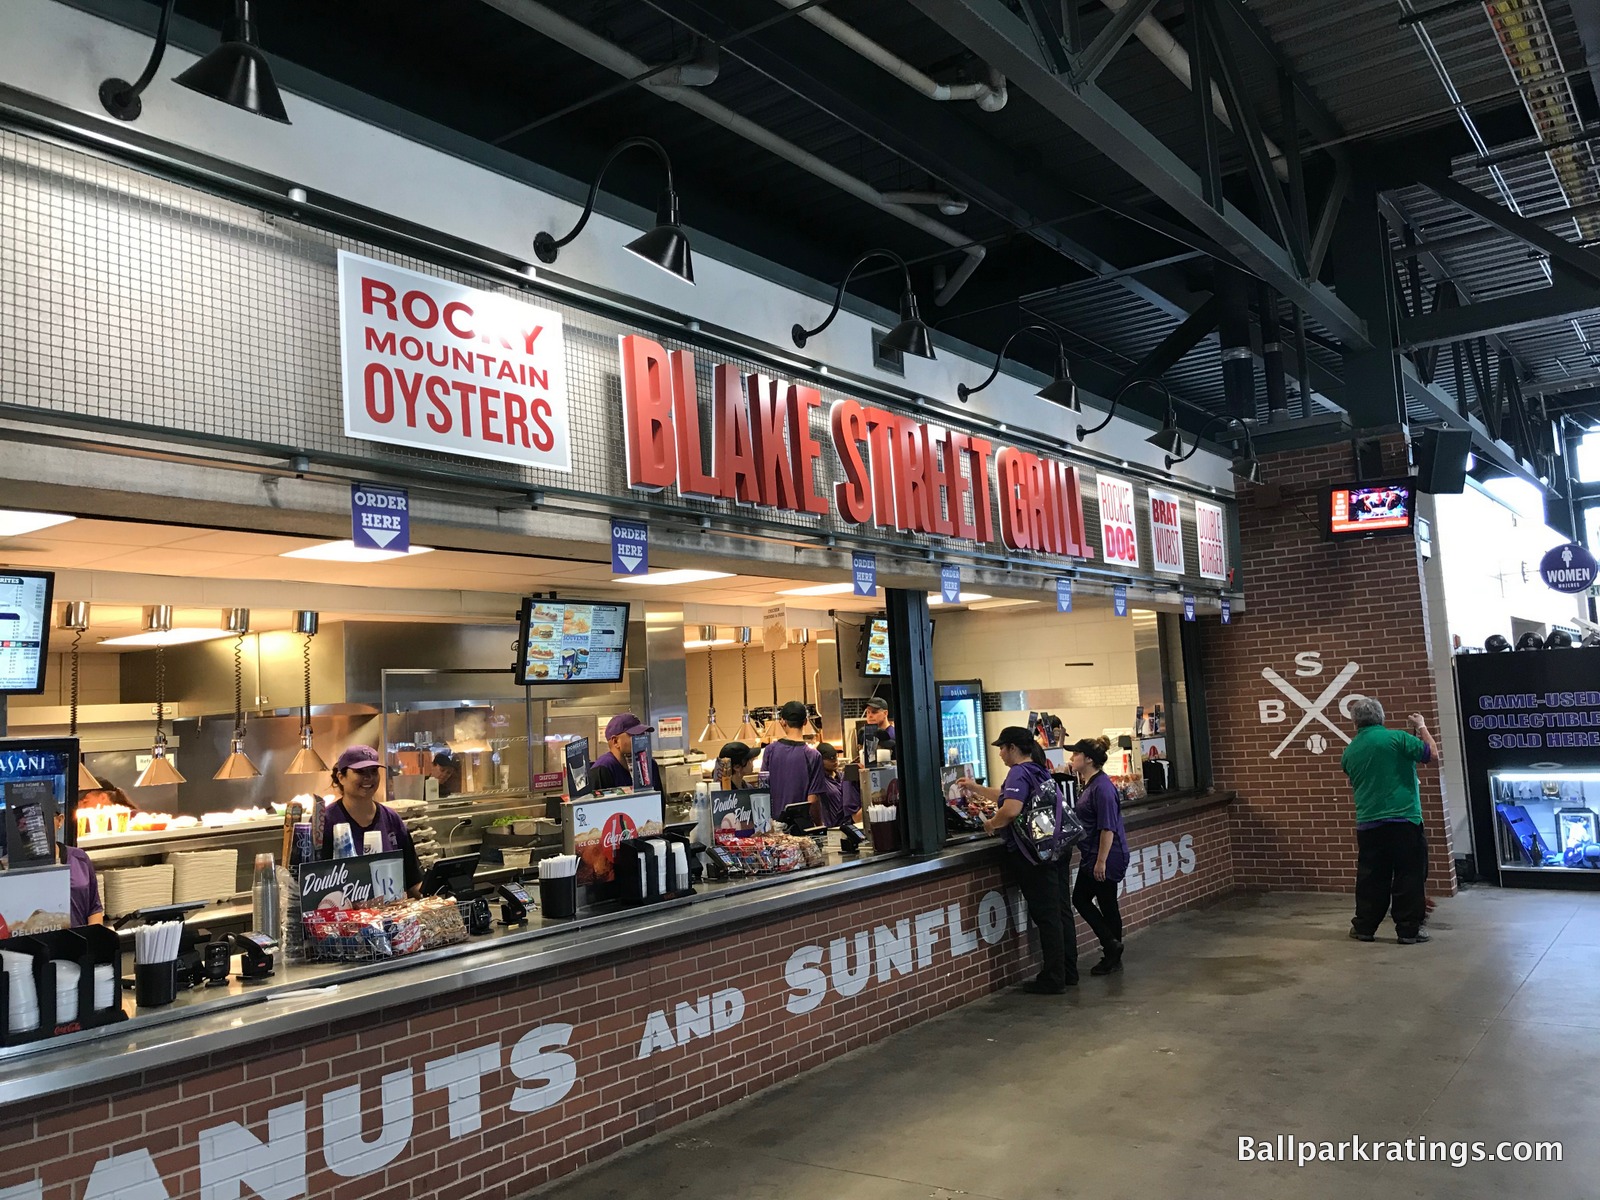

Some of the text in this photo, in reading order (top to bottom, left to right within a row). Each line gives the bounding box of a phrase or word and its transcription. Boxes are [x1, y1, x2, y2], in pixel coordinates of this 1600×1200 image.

[365, 326, 549, 391] MOUNTAIN
[364, 362, 555, 453] OYSTERS
[618, 334, 1094, 561] BLAKE STREET GRILL
[354, 491, 407, 511] ORDER
[361, 513, 401, 530] HERE
[1152, 498, 1177, 527] BRAT
[612, 526, 647, 542] ORDER
[1104, 525, 1136, 562] DOG
[617, 543, 643, 557] HERE
[1154, 527, 1181, 566] WURST
[853, 558, 876, 569] ORDER
[856, 572, 873, 582] HERE
[941, 569, 960, 579] ORDER
[1547, 568, 1591, 583] WOMEN
[1295, 651, 1323, 676] S
[1479, 691, 1600, 710] GAME-USED
[1258, 700, 1287, 724] B
[1488, 732, 1600, 749] SOLD HERE
[713, 793, 739, 814] Double
[734, 806, 752, 826] Play
[588, 839, 600, 847] COLD
[302, 862, 349, 897] Double
[341, 879, 372, 908] Play
[11, 924, 62, 938] DELICIOUS
[637, 987, 746, 1060] AND
